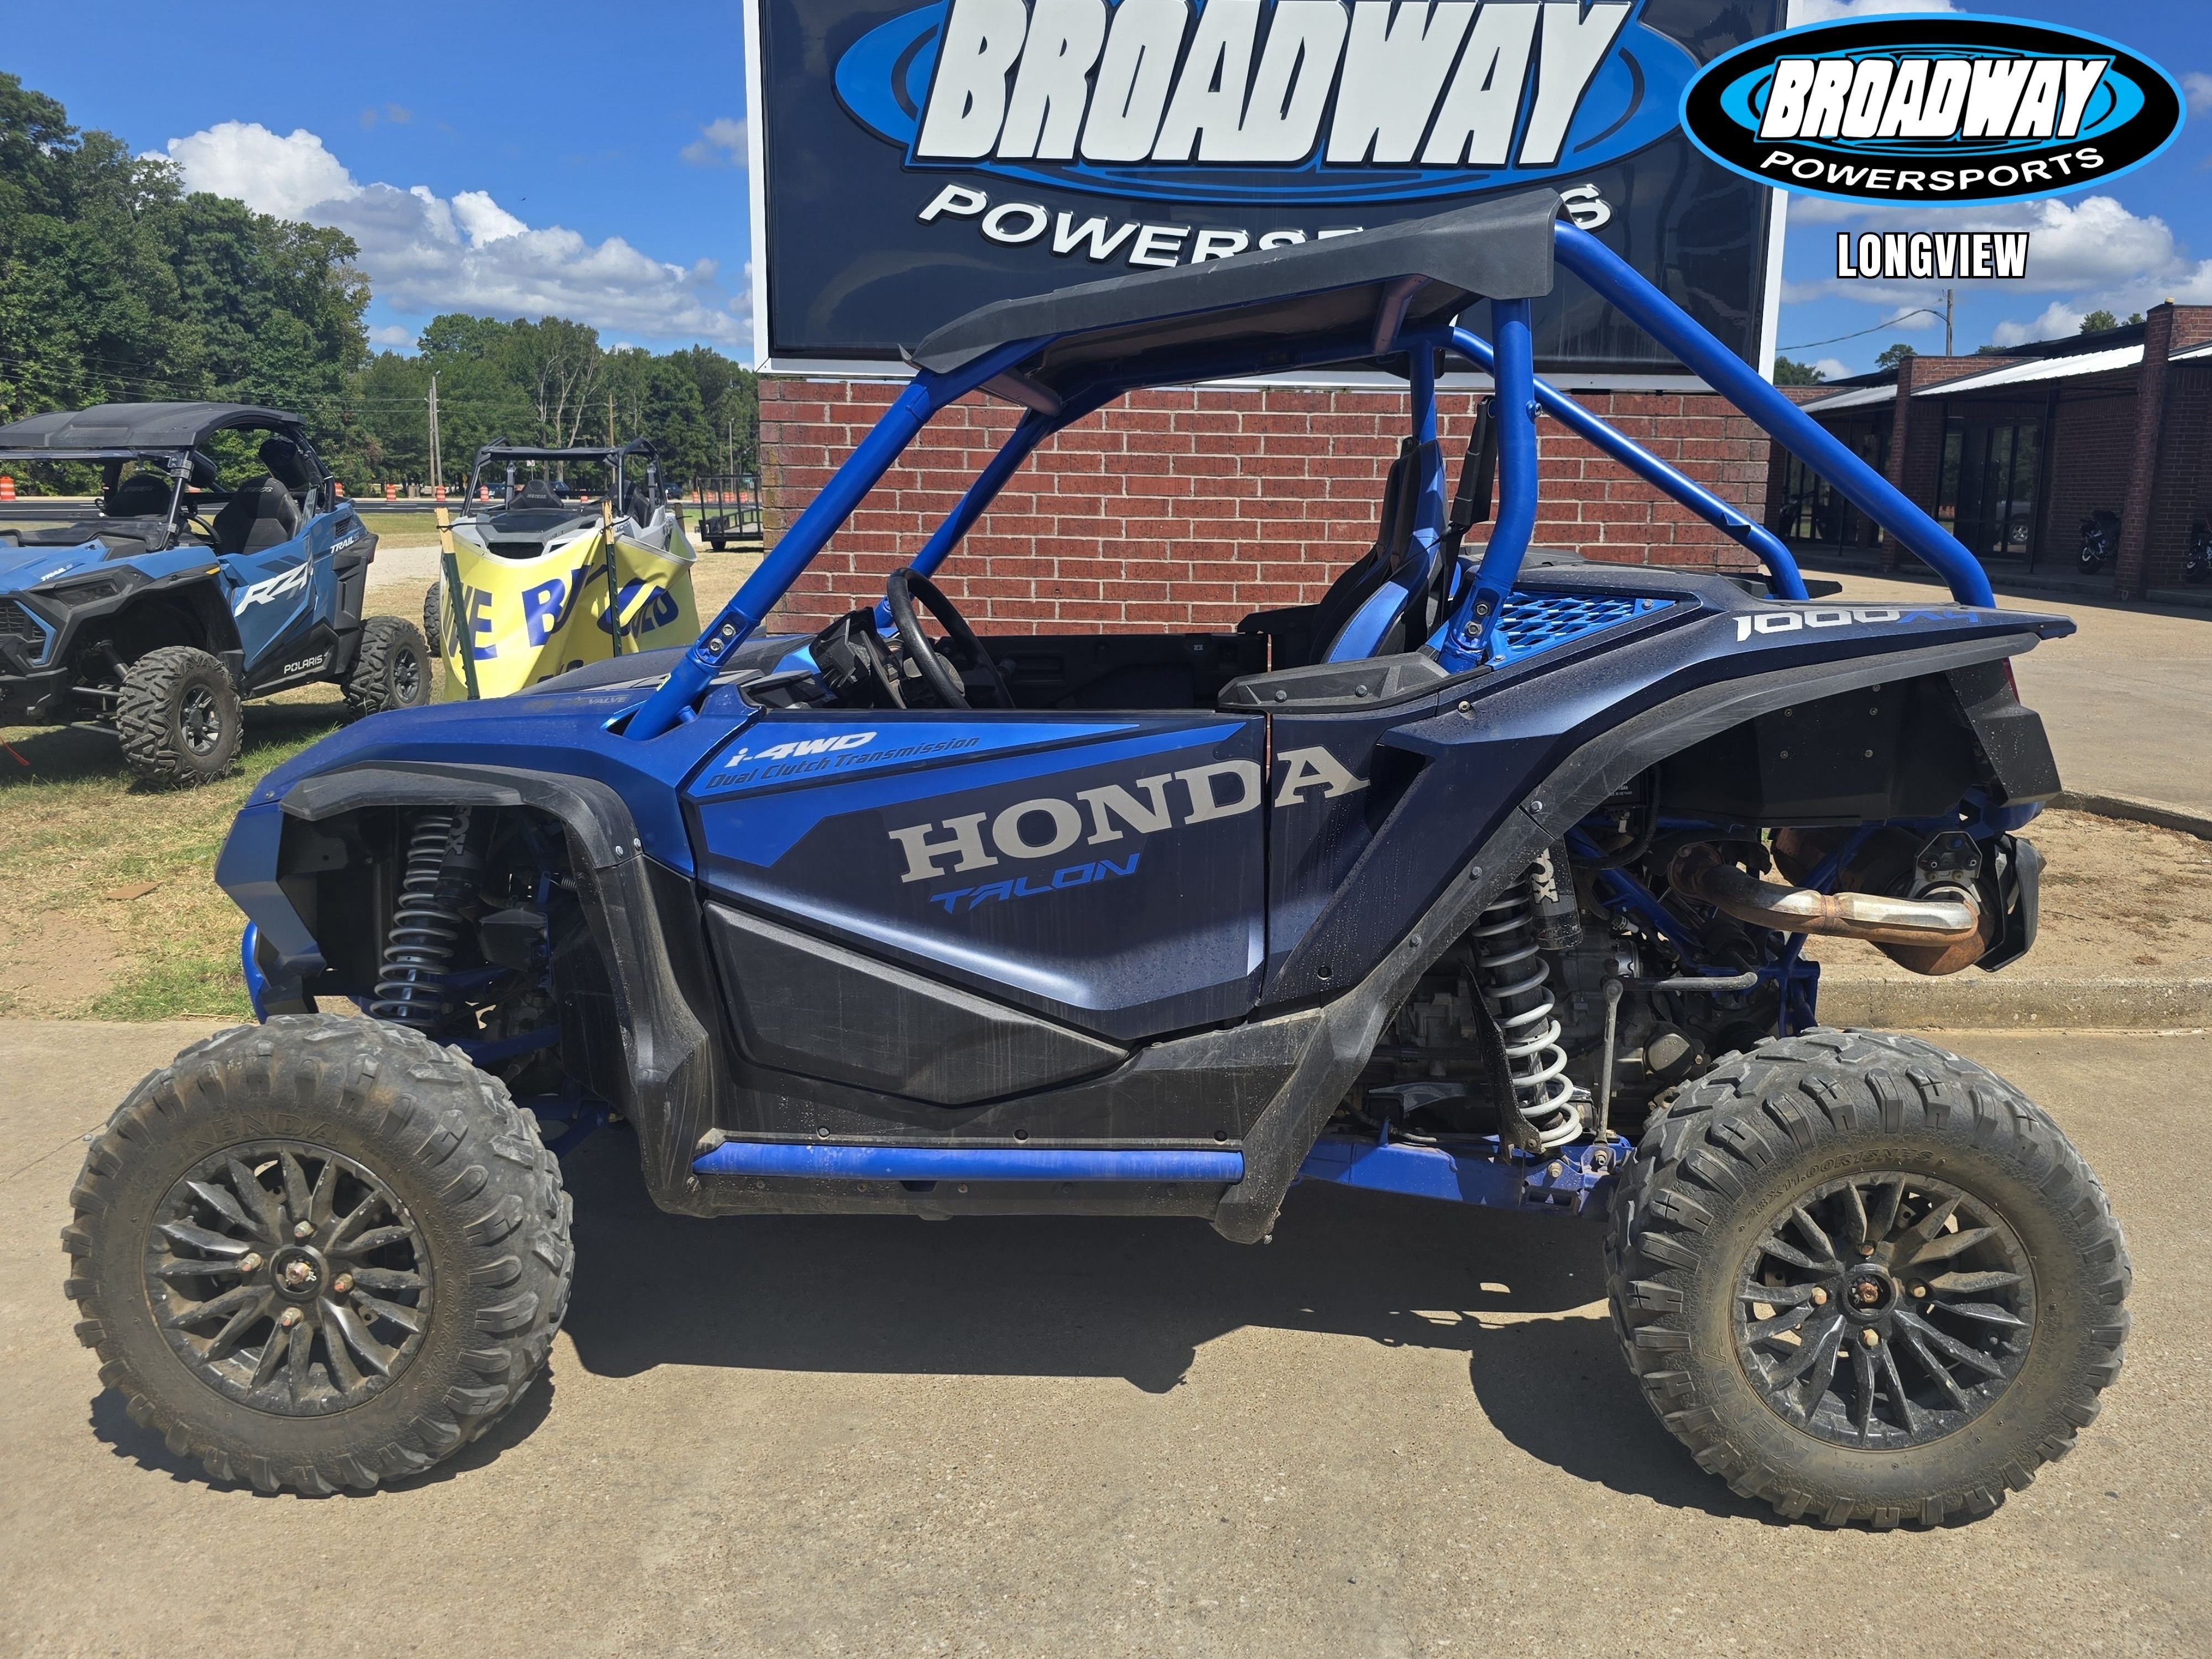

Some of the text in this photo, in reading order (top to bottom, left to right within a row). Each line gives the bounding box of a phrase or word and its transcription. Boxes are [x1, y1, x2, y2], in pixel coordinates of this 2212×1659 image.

[916, 0, 1631, 165] BROADWAY
[330, 536, 354, 553] TRAIL
[40, 567, 66, 581] TRAIL
[284, 654, 322, 674] POLARIS
[588, 696, 627, 705] VALVE
[705, 737, 981, 790] Dual Clutch Transmission
[724, 731, 878, 768] i-4WD
[888, 744, 1371, 884] HONDA
[929, 852, 1141, 914] TALON
[176, 1112, 340, 1159] KENDA
[1701, 1331, 1810, 1470] KENDA
